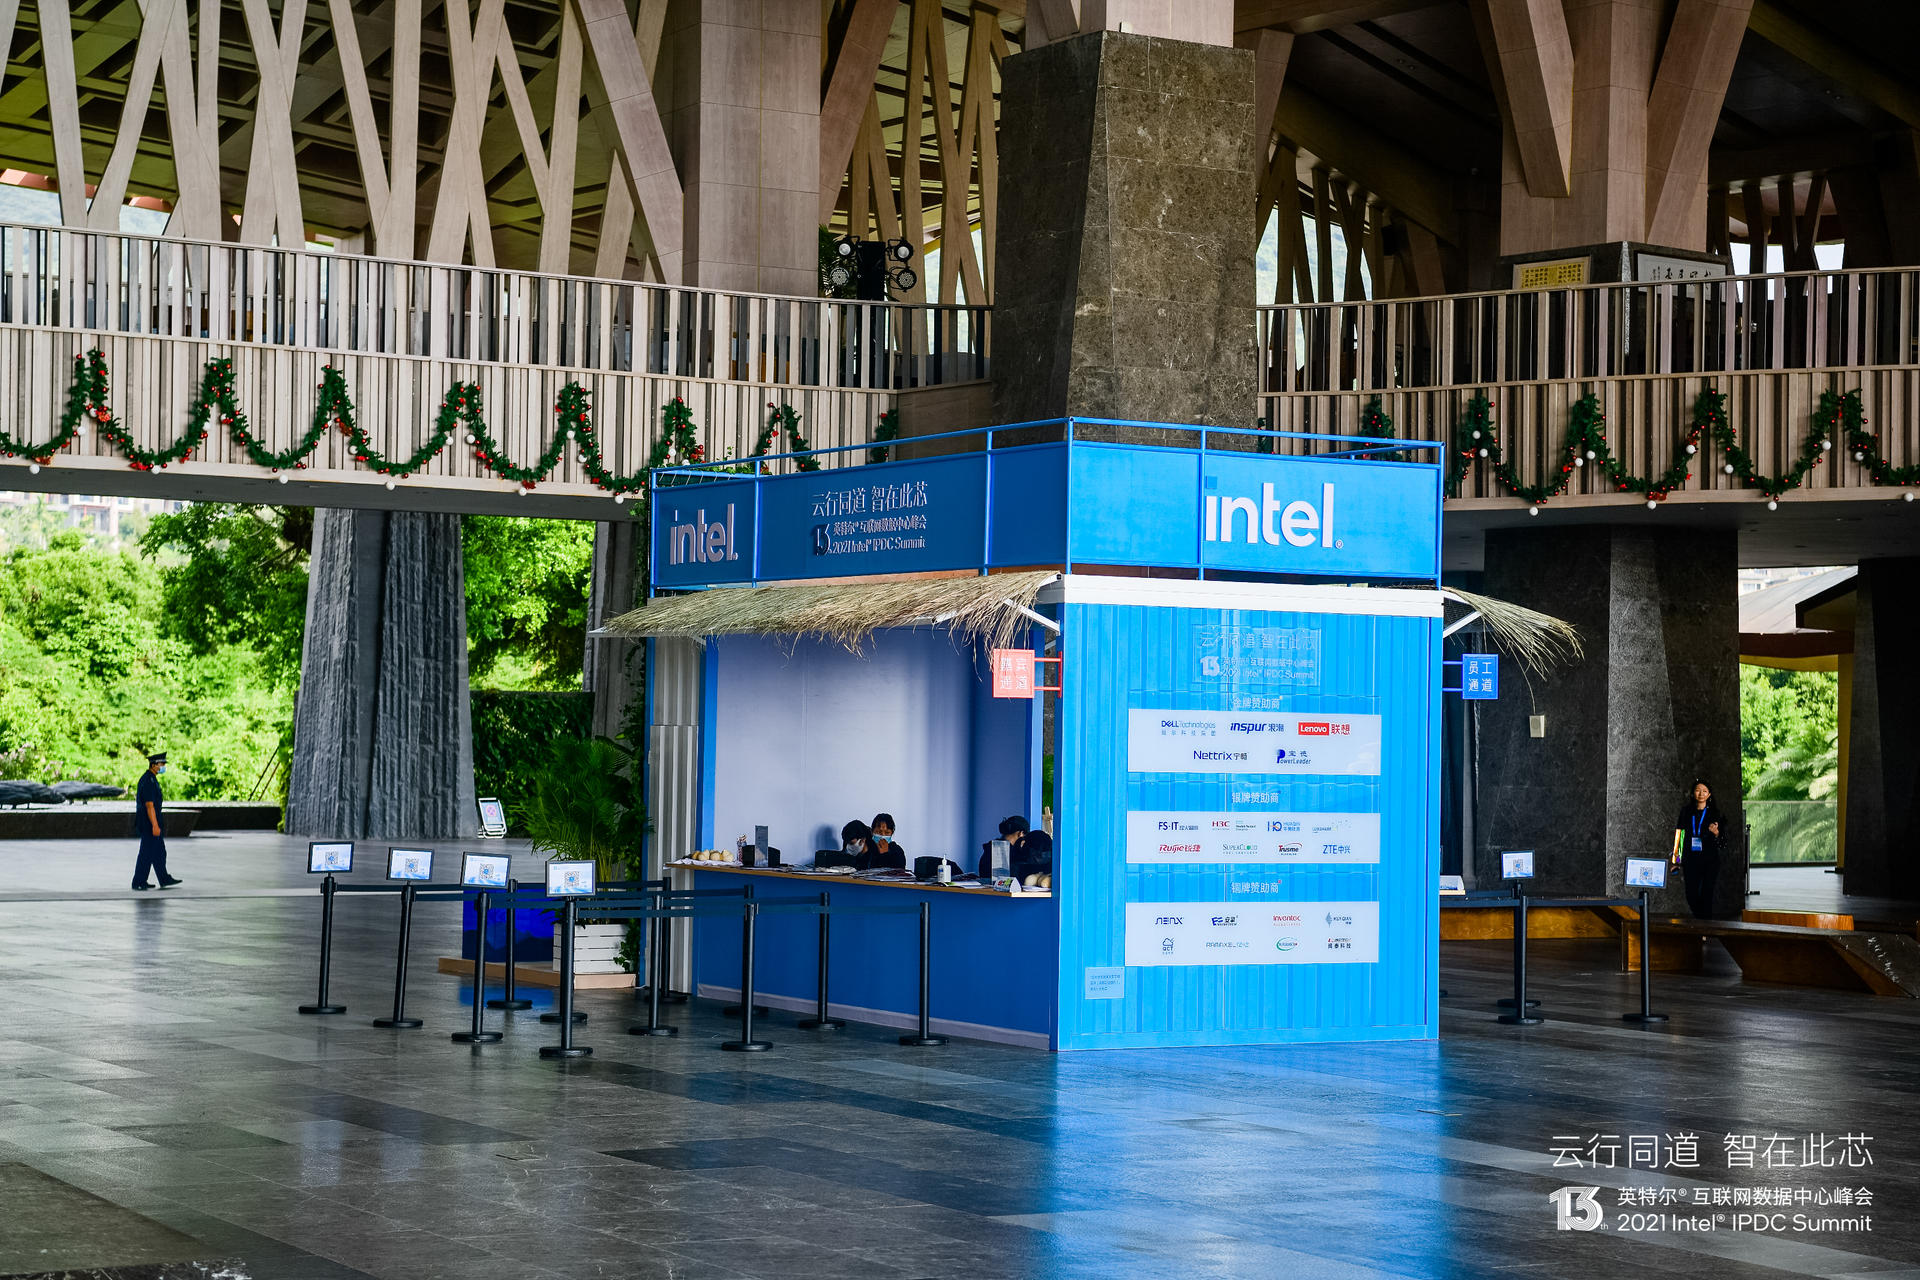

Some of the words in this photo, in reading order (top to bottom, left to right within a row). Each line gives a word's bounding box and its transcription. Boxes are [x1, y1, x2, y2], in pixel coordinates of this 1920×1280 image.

[811, 488, 866, 517] 云行同道
[871, 481, 928, 512] 智在此芯
[1468, 661, 1492, 674] 员工
[1468, 678, 1492, 692] 通道
[1230, 722, 1267, 734] inspur
[1300, 725, 1327, 733] Lenovo
[1331, 724, 1350, 735] 联想
[1193, 750, 1232, 760] Nettrix
[1232, 792, 1279, 804] 银牌赞助商
[1212, 820, 1230, 828] H3C
[1322, 844, 1337, 854] ZTE
[1337, 844, 1351, 854] 中兴
